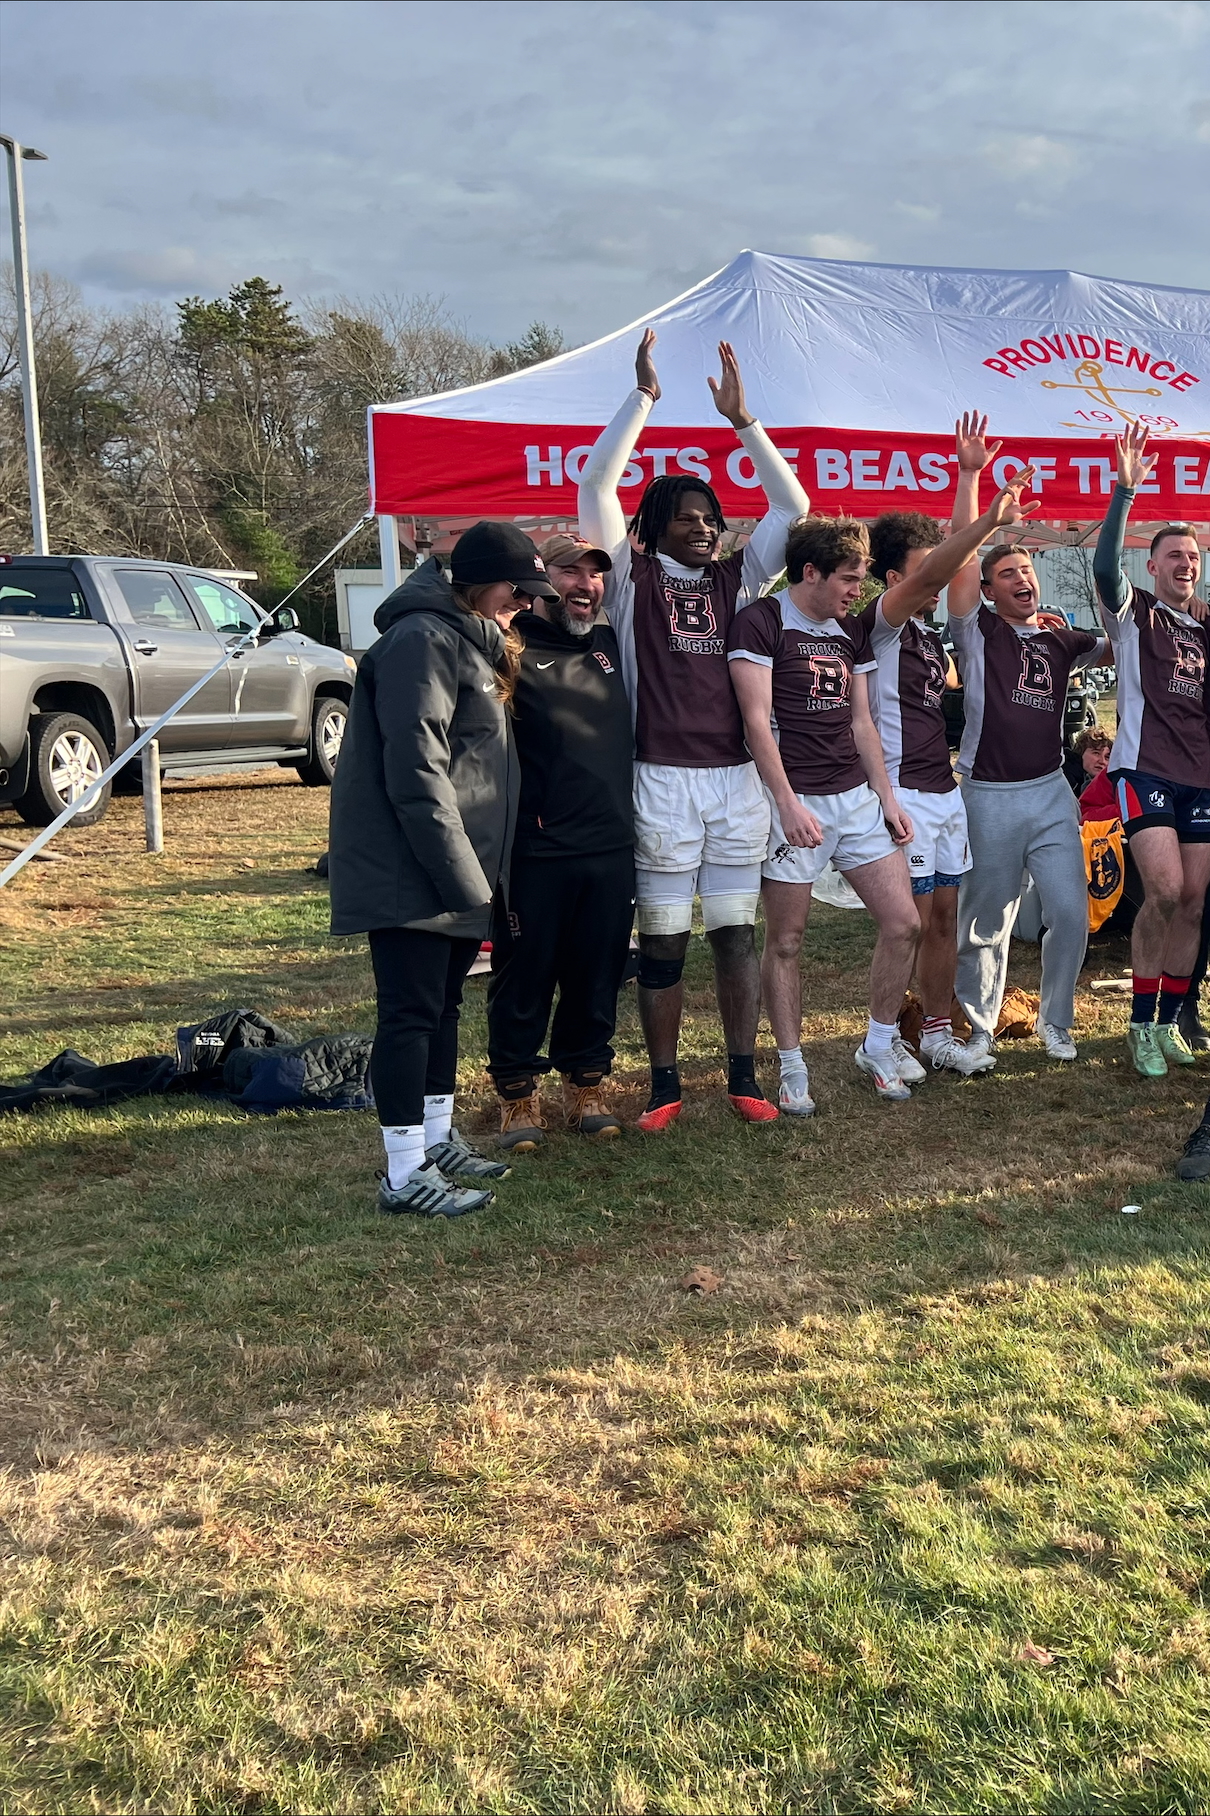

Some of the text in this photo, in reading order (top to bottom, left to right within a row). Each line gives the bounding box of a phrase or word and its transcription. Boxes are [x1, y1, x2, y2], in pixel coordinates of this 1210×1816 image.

[982, 333, 1200, 392] PROVIDENCE
[814, 448, 959, 492] BEAS
[993, 455, 1056, 494] OF
[664, 587, 717, 639] B
[668, 636, 724, 655] RUGBY
[809, 655, 849, 703] B
[1011, 689, 1056, 712] RUGBY
